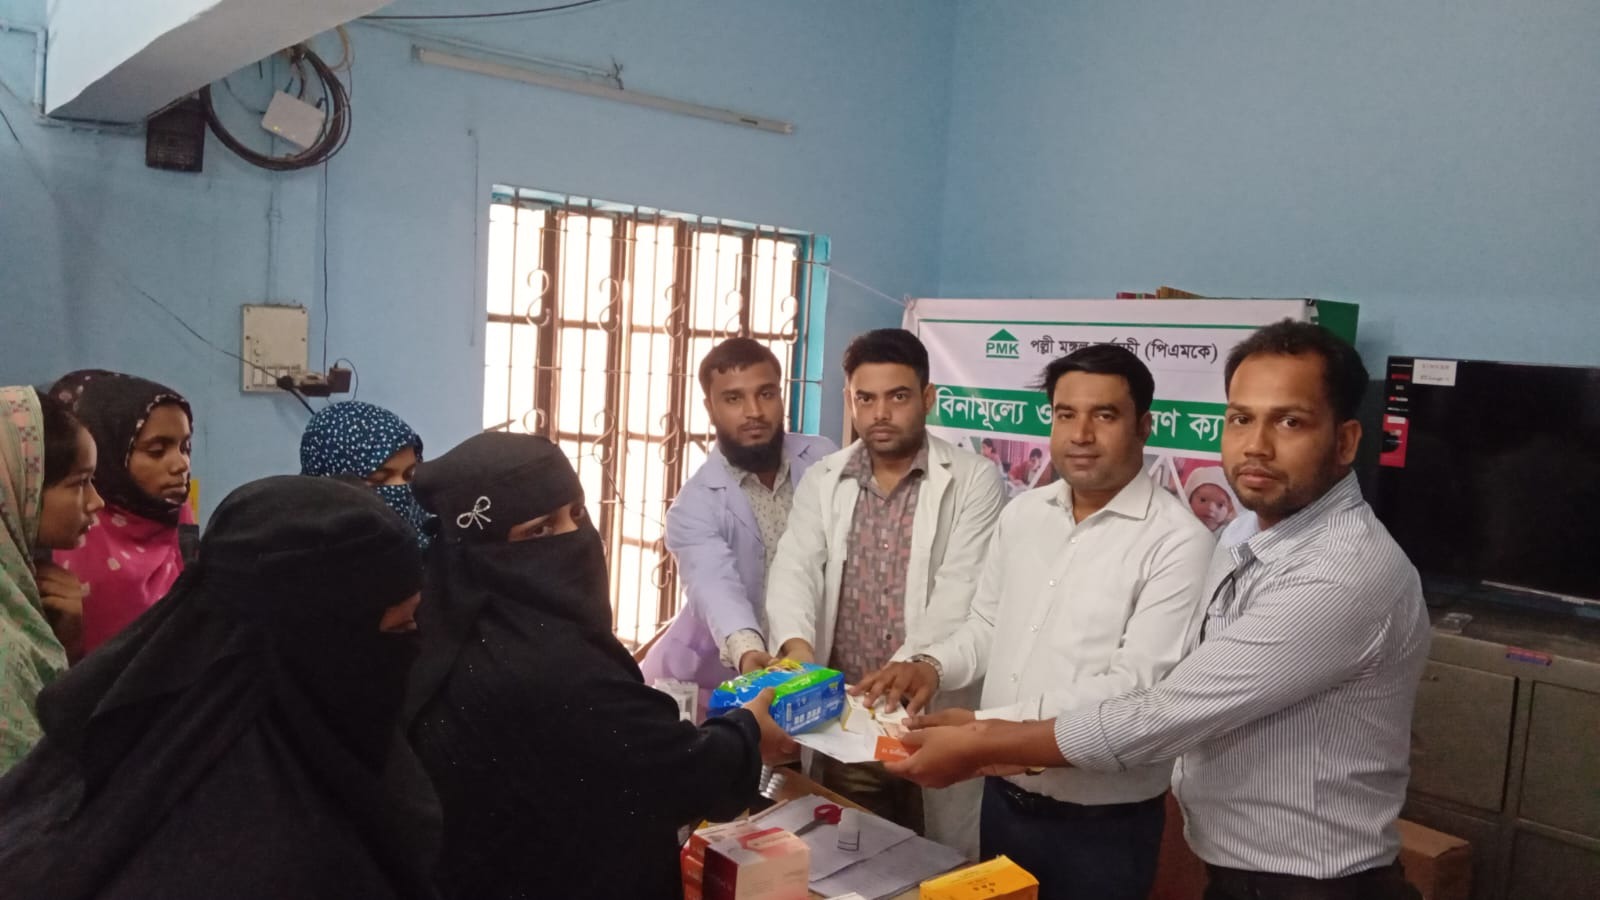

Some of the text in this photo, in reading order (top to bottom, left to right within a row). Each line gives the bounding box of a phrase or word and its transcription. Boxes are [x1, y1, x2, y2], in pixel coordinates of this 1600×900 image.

[986, 342, 1019, 355] PMK
[1030, 335, 1055, 354] পল্লী
[1145, 338, 1218, 365] (পিএমকে)
[936, 387, 1028, 430] বিনামূল্যে
